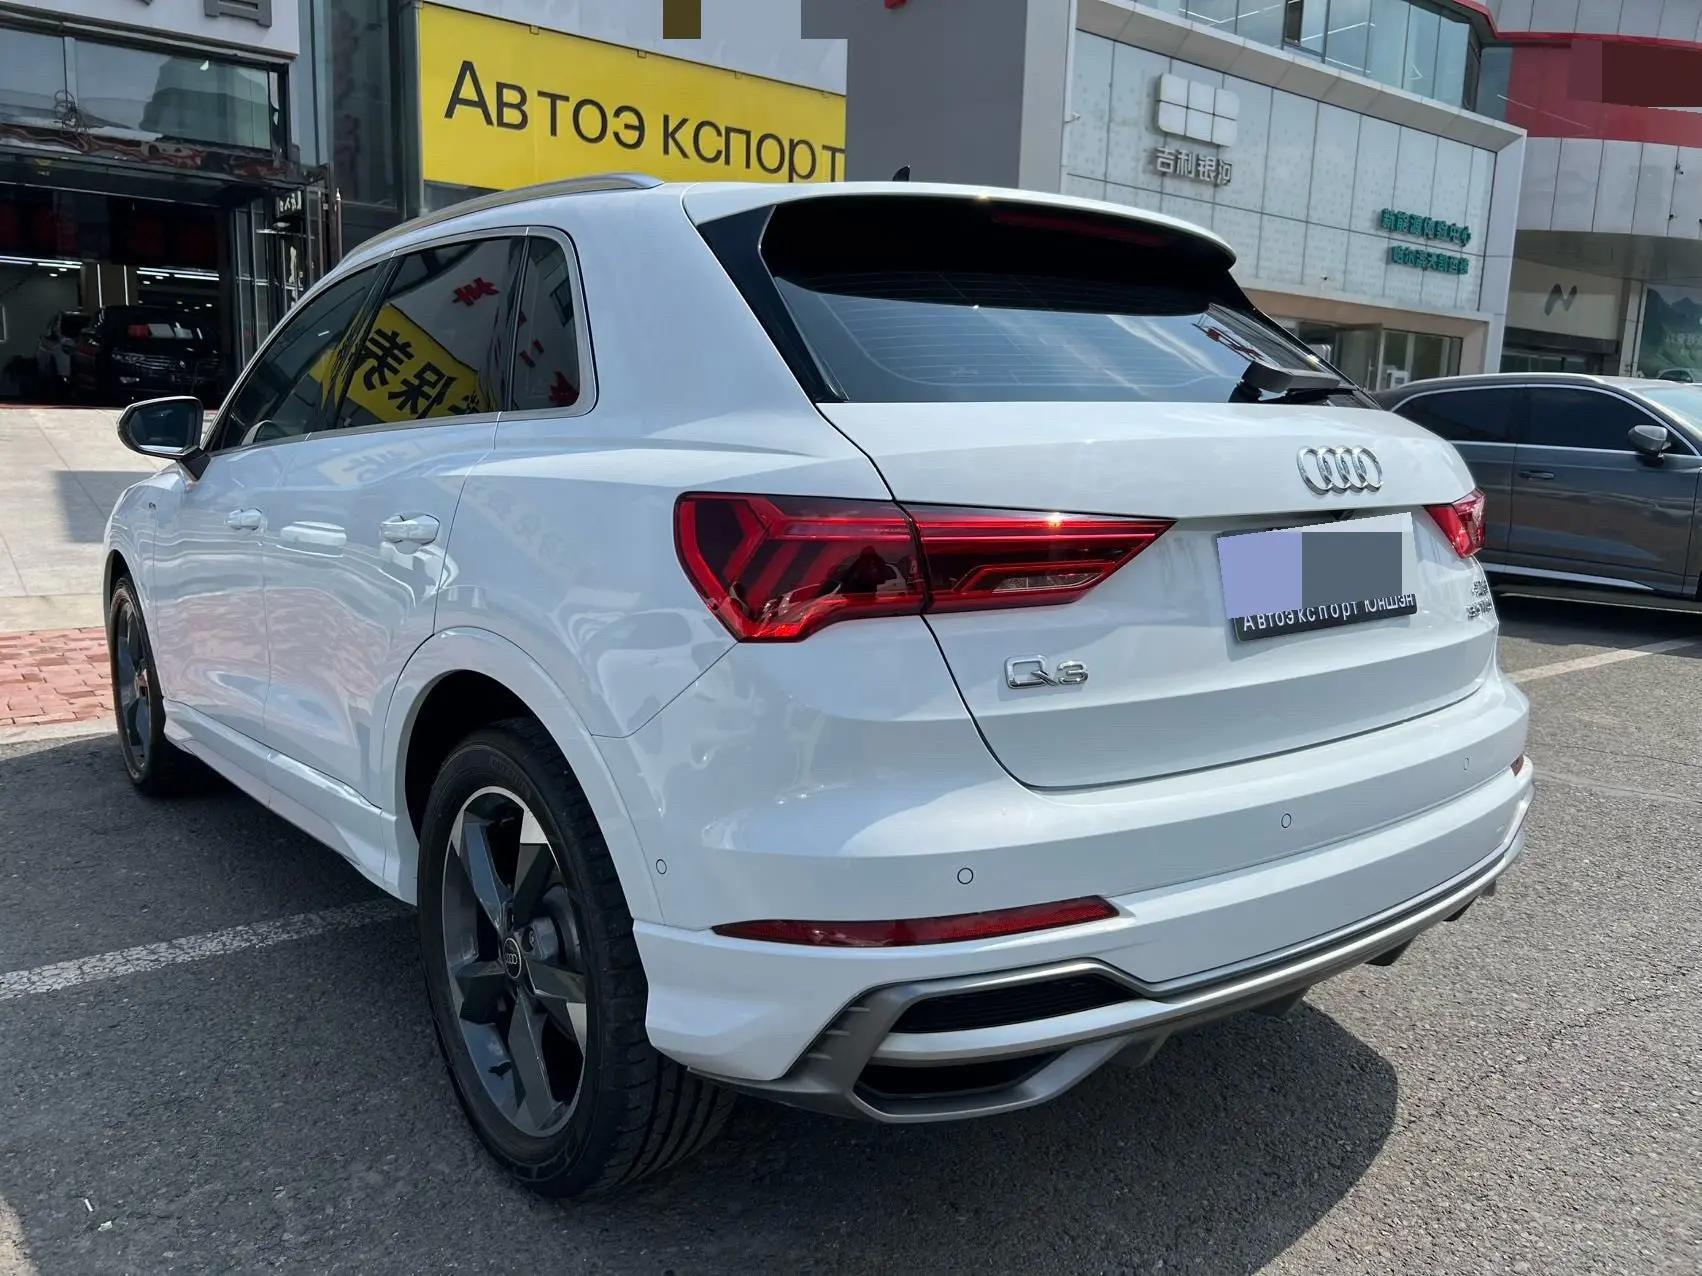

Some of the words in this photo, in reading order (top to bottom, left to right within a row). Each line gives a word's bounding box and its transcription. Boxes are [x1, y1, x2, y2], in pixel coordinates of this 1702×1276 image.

[1156, 146, 1233, 185] 吉利银河
[1004, 654, 1089, 689] Q3
